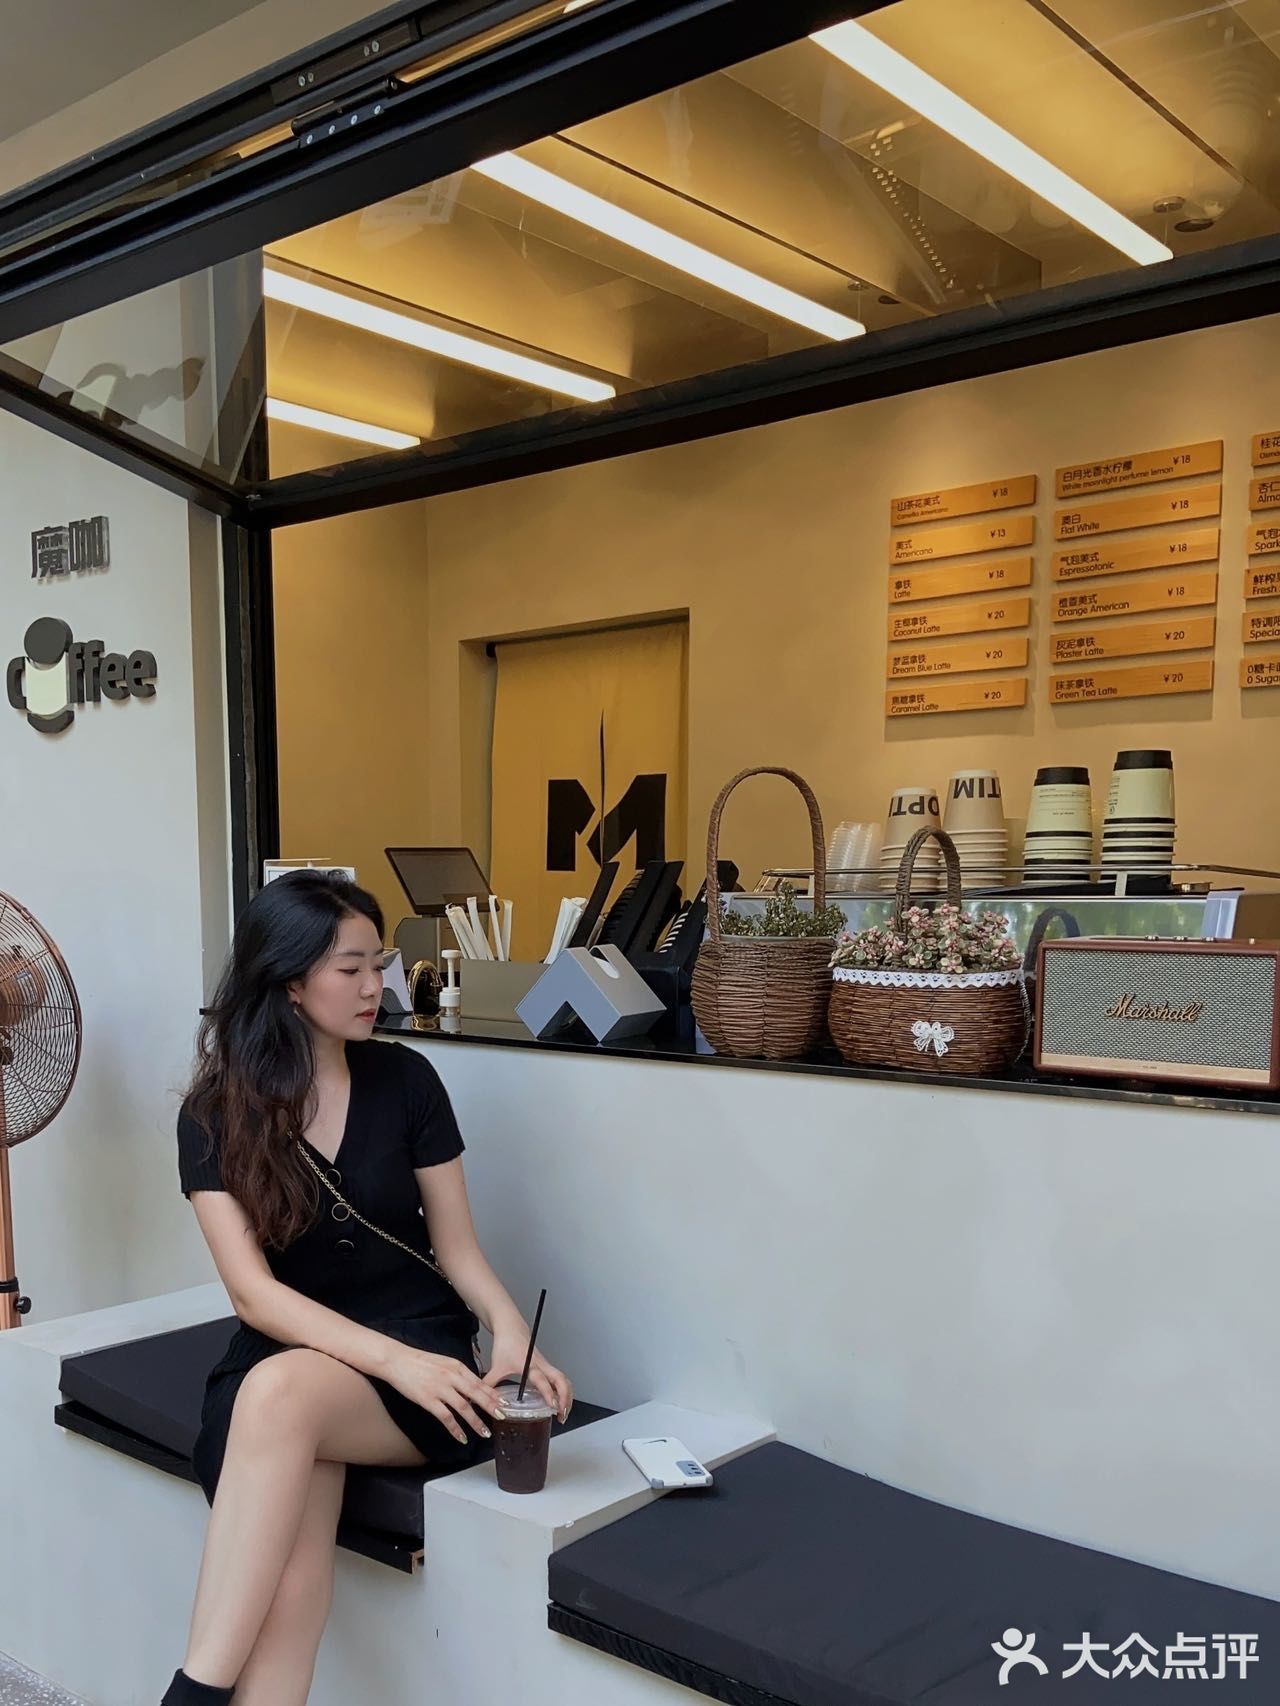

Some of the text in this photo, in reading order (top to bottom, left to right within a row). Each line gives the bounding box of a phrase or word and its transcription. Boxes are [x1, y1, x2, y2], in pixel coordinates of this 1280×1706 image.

[1119, 470, 1150, 483] perfume
[1150, 466, 1174, 477] lemon
[1060, 522, 1100, 536] Flat White
[895, 539, 913, 551] 美式
[895, 547, 934, 559] Americano
[1060, 551, 1100, 566] 气泡美式
[895, 579, 912, 590] 拿铁
[1252, 585, 1277, 595] Fresh
[894, 590, 911, 599] Latte
[1057, 601, 1130, 618] Orange American
[893, 625, 941, 637] Coconut Latte
[1056, 647, 1104, 660] Plaster Latte
[892, 662, 951, 675] Dream Blue Latte
[1255, 674, 1280, 684] Suga
[1055, 686, 1118, 700] Green Tea Latte
[891, 703, 939, 714] Caramel Latte
[1105, 993, 1203, 1022] Marshall
